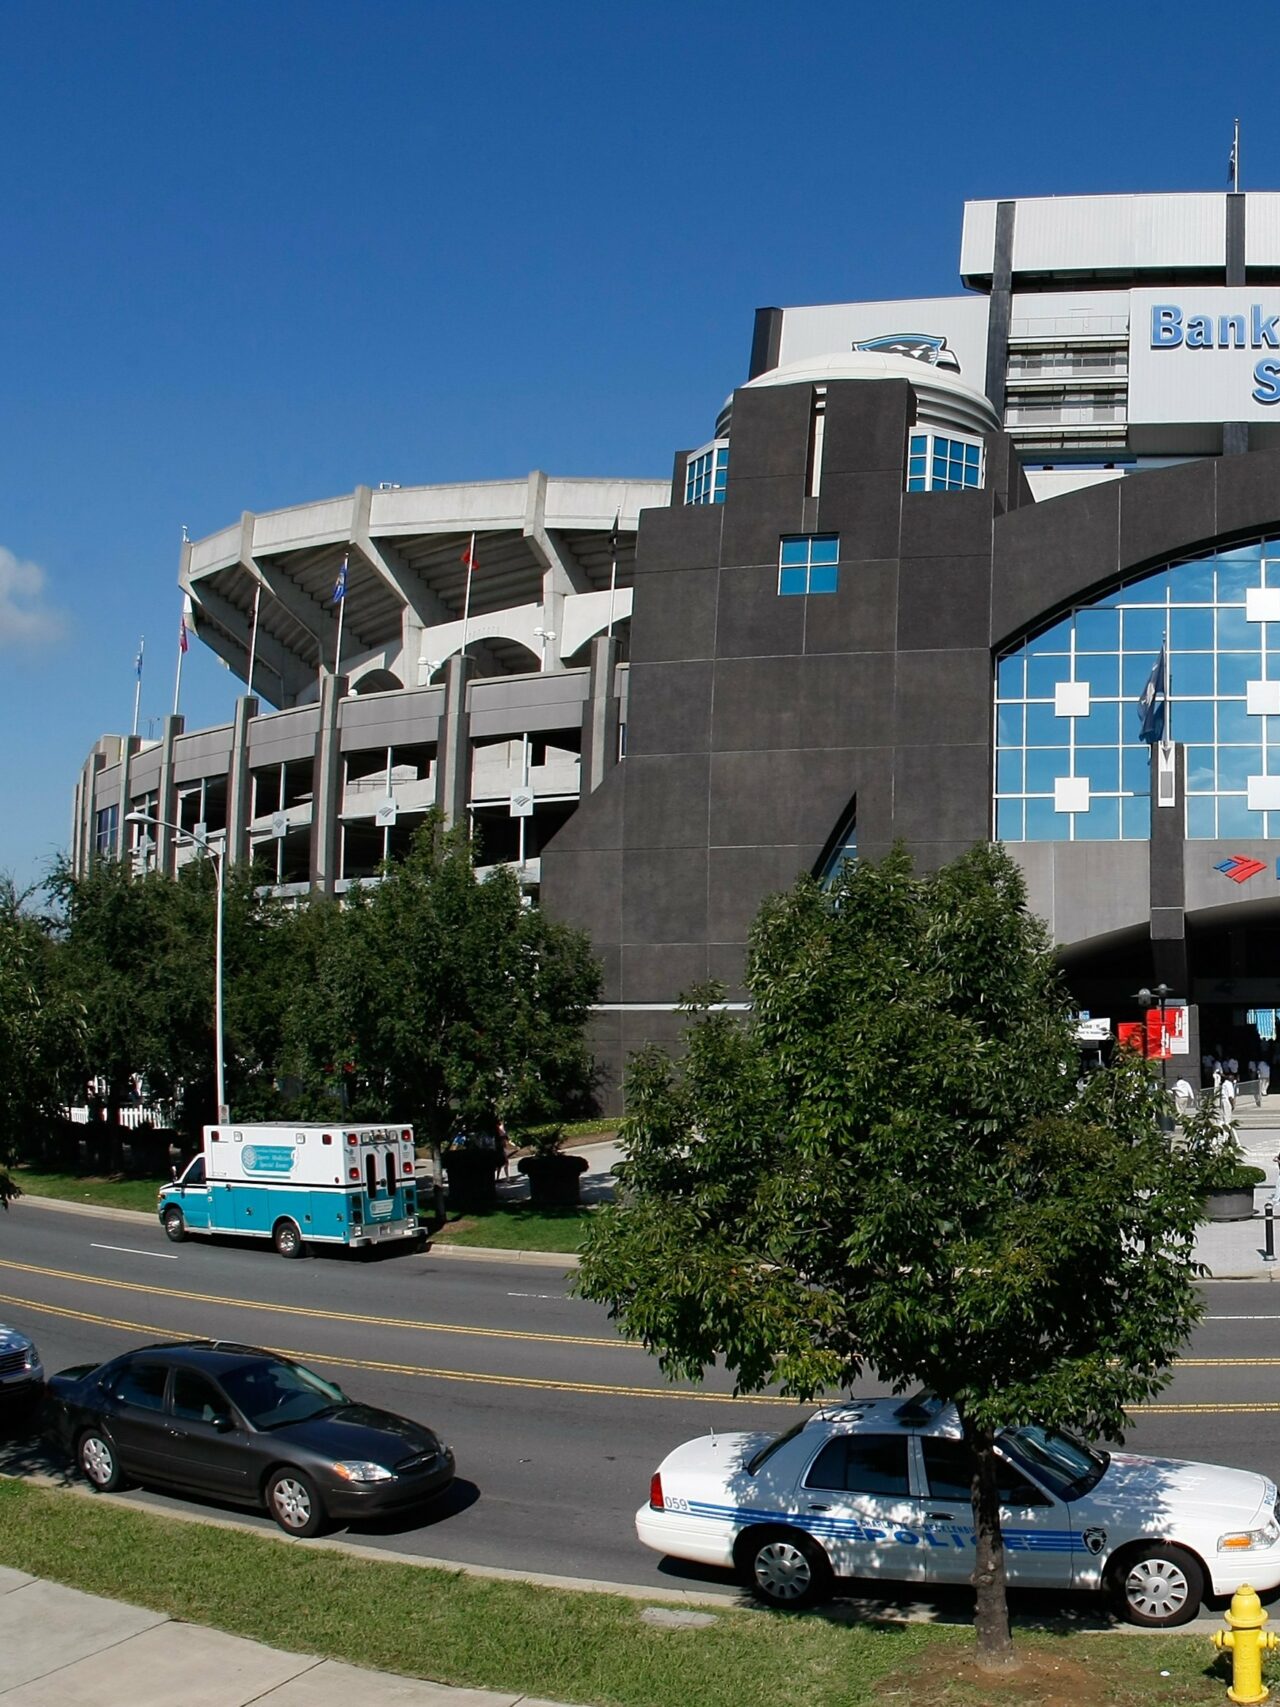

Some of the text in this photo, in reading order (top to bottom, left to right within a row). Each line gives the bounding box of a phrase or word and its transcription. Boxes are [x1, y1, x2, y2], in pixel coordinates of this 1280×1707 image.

[1150, 304, 1280, 350] Bank
[665, 1496, 688, 1511] 059
[923, 1523, 976, 1535] MECKLENBU
